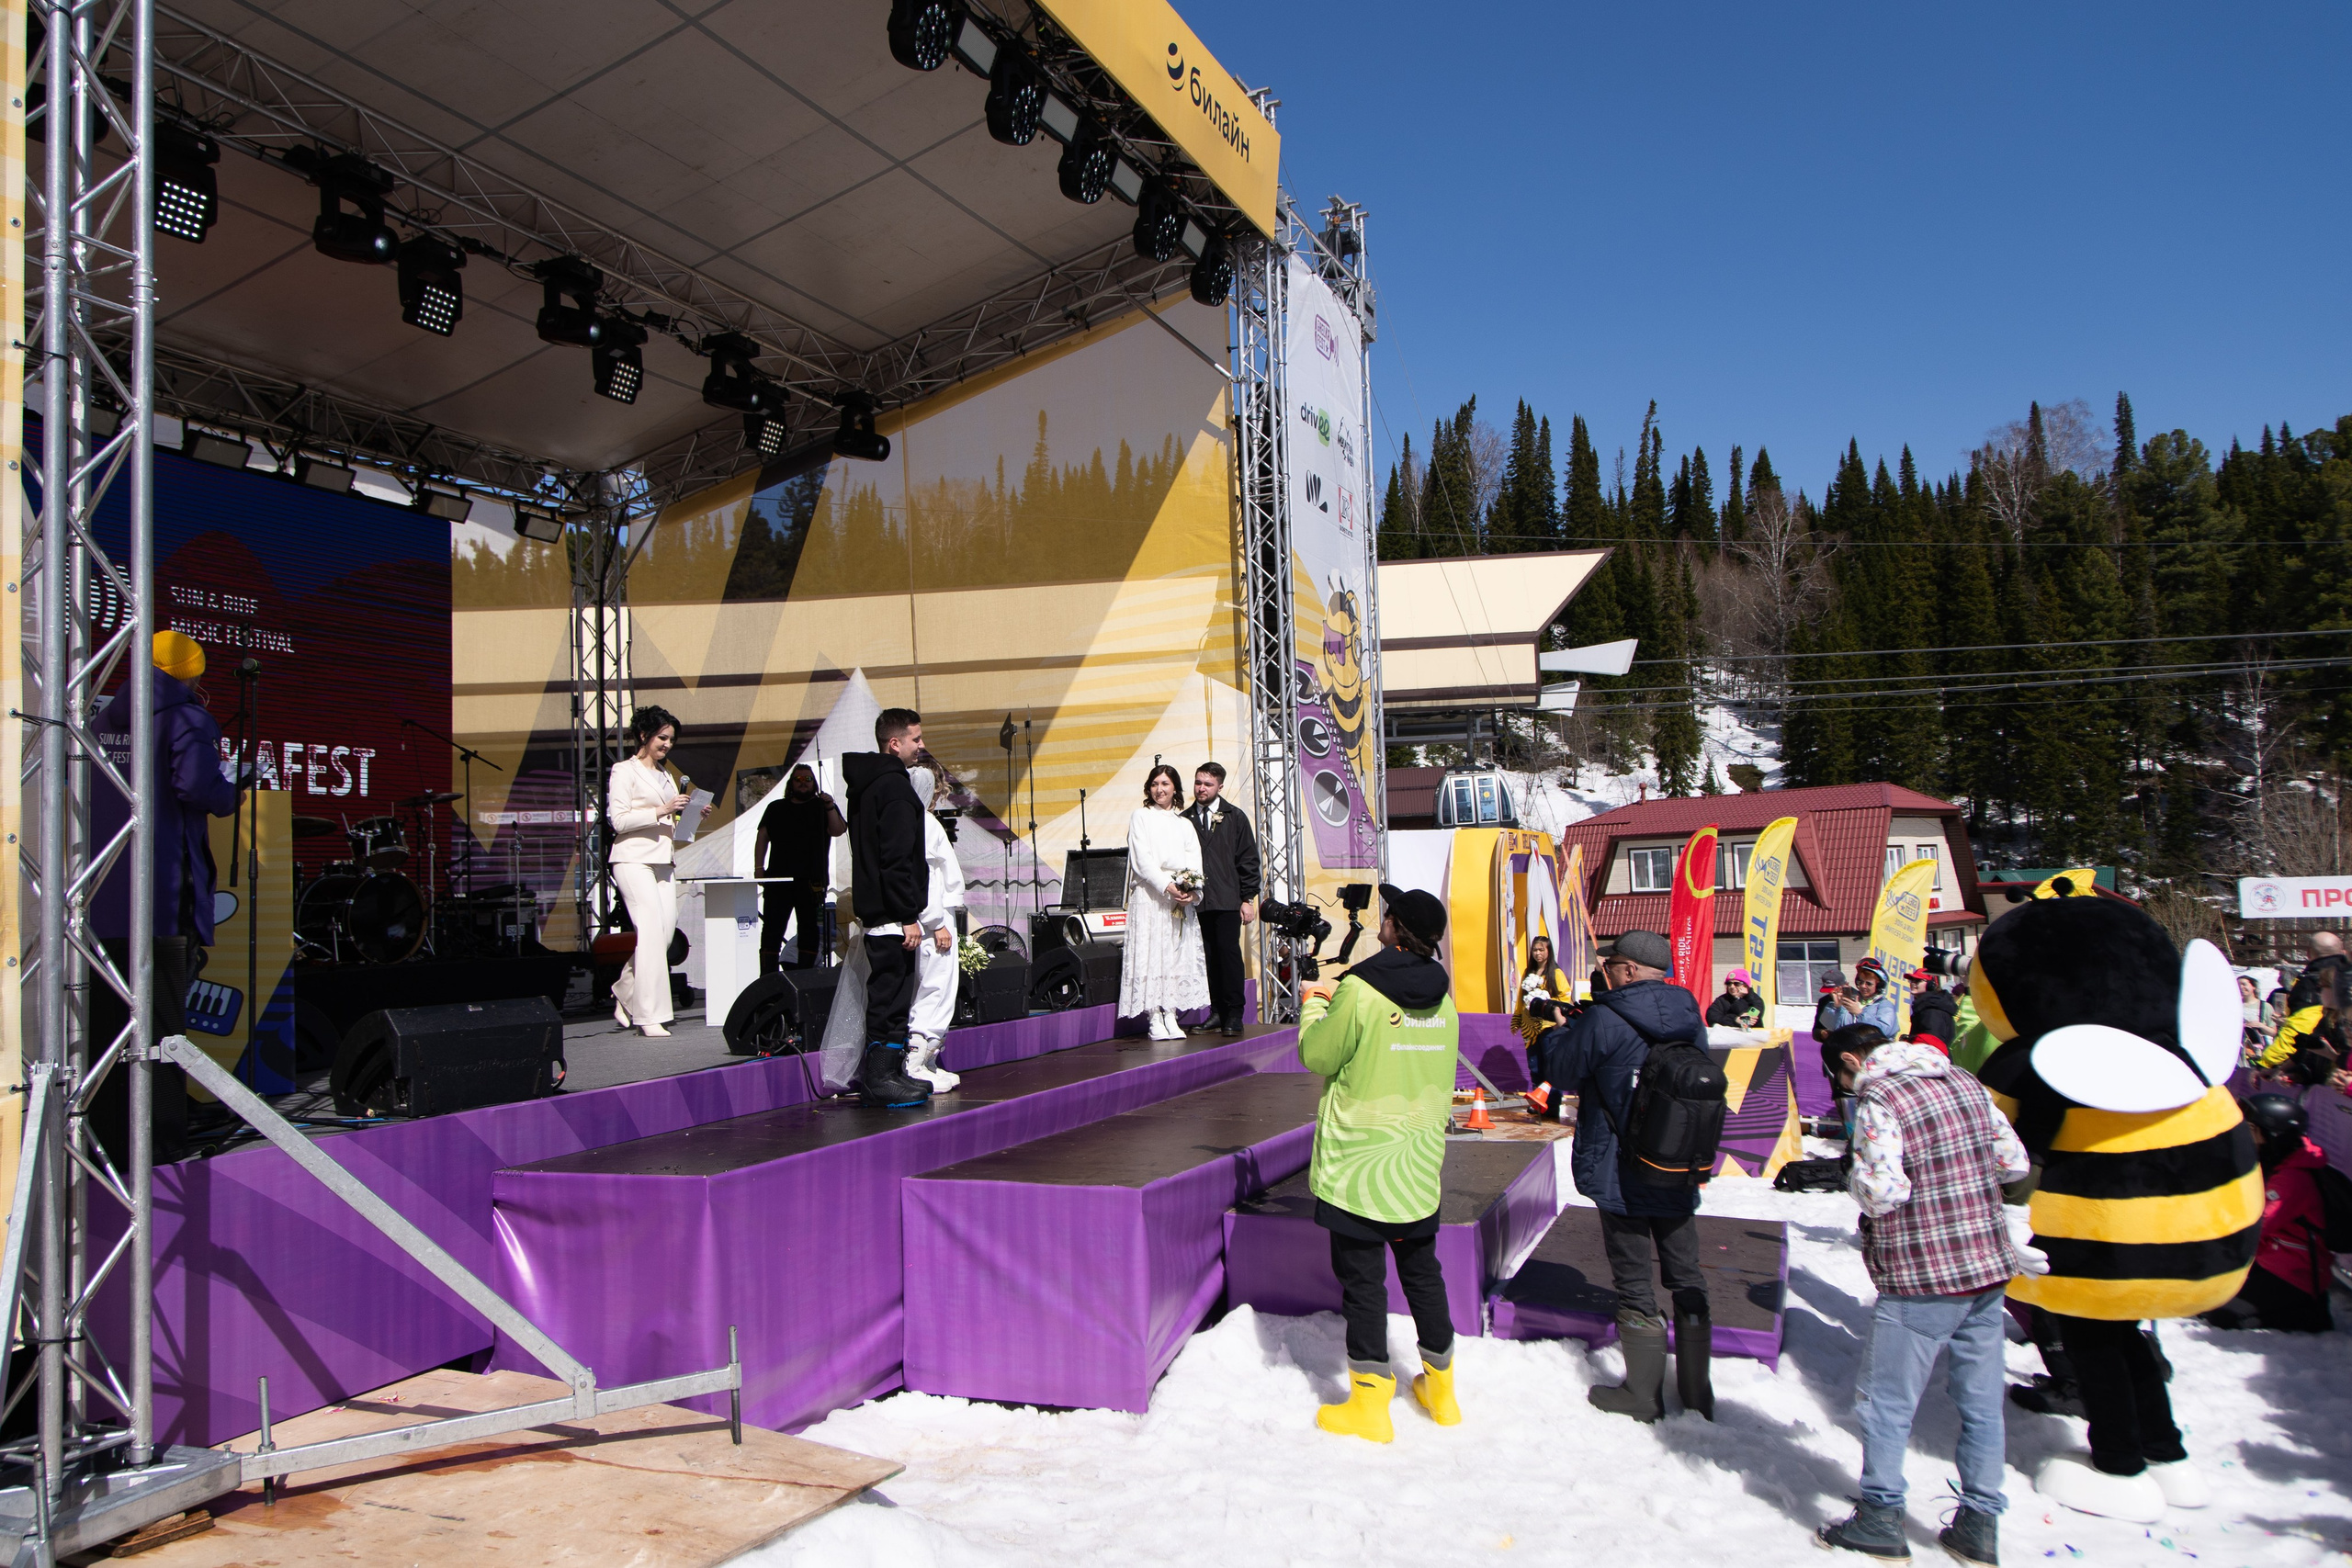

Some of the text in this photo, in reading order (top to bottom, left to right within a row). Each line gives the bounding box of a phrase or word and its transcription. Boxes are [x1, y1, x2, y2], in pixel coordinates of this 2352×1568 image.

[1190, 67, 1250, 163] билайн
[1300, 401, 1330, 442] drivee
[170, 586, 204, 606] SUN
[223, 594, 259, 615] RIDE
[170, 617, 223, 644] MUSIC
[98, 732, 115, 746] SUN
[115, 734, 122, 745] &
[1404, 1012, 1446, 1028] билайн
